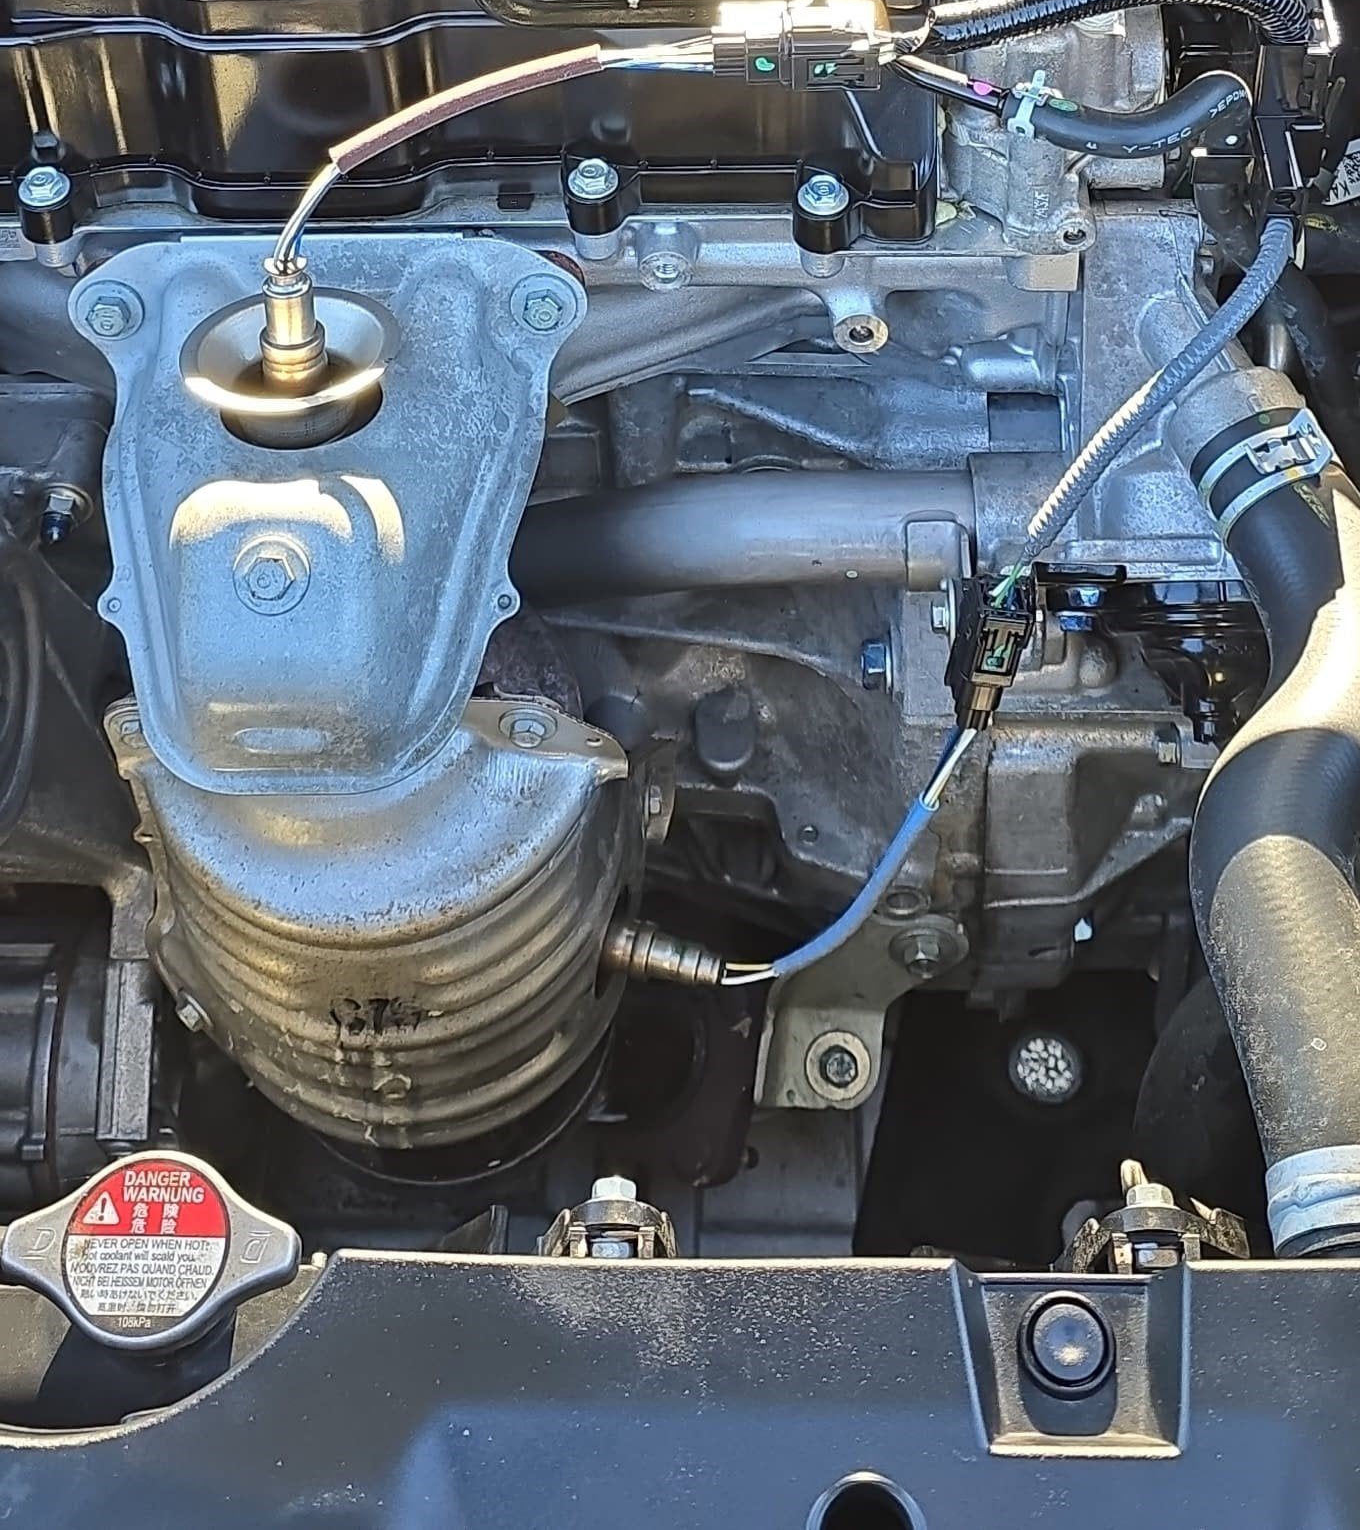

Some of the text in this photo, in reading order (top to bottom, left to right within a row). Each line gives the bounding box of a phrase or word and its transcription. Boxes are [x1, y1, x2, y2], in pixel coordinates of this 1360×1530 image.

[1122, 126, 1193, 155] Y-TEC
[124, 1171, 190, 1187] DANGER
[123, 1187, 205, 1203] WARNUNG
[120, 1239, 150, 1250] OPEN
[151, 1239, 182, 1250] WHEN
[100, 1250, 133, 1262] coolant
[151, 1251, 175, 1262] scald
[120, 1263, 139, 1274] PAS
[141, 1263, 177, 1275] QUAND
[146, 1277, 175, 1288] MOTOR
